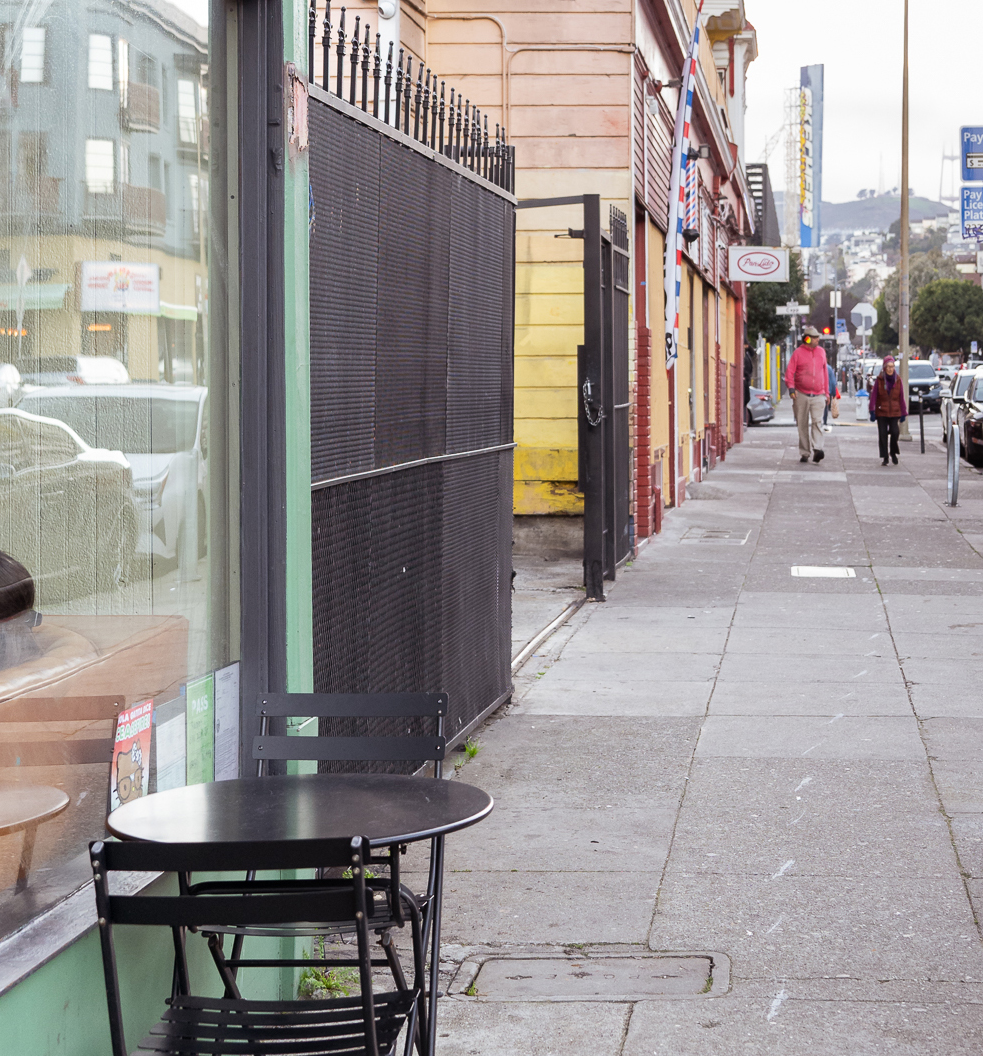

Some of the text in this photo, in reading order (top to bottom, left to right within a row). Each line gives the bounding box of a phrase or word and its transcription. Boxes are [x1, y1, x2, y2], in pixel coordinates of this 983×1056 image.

[963, 131, 983, 144] Pay
[963, 189, 982, 201] Pay
[191, 695, 208, 716] PASS
